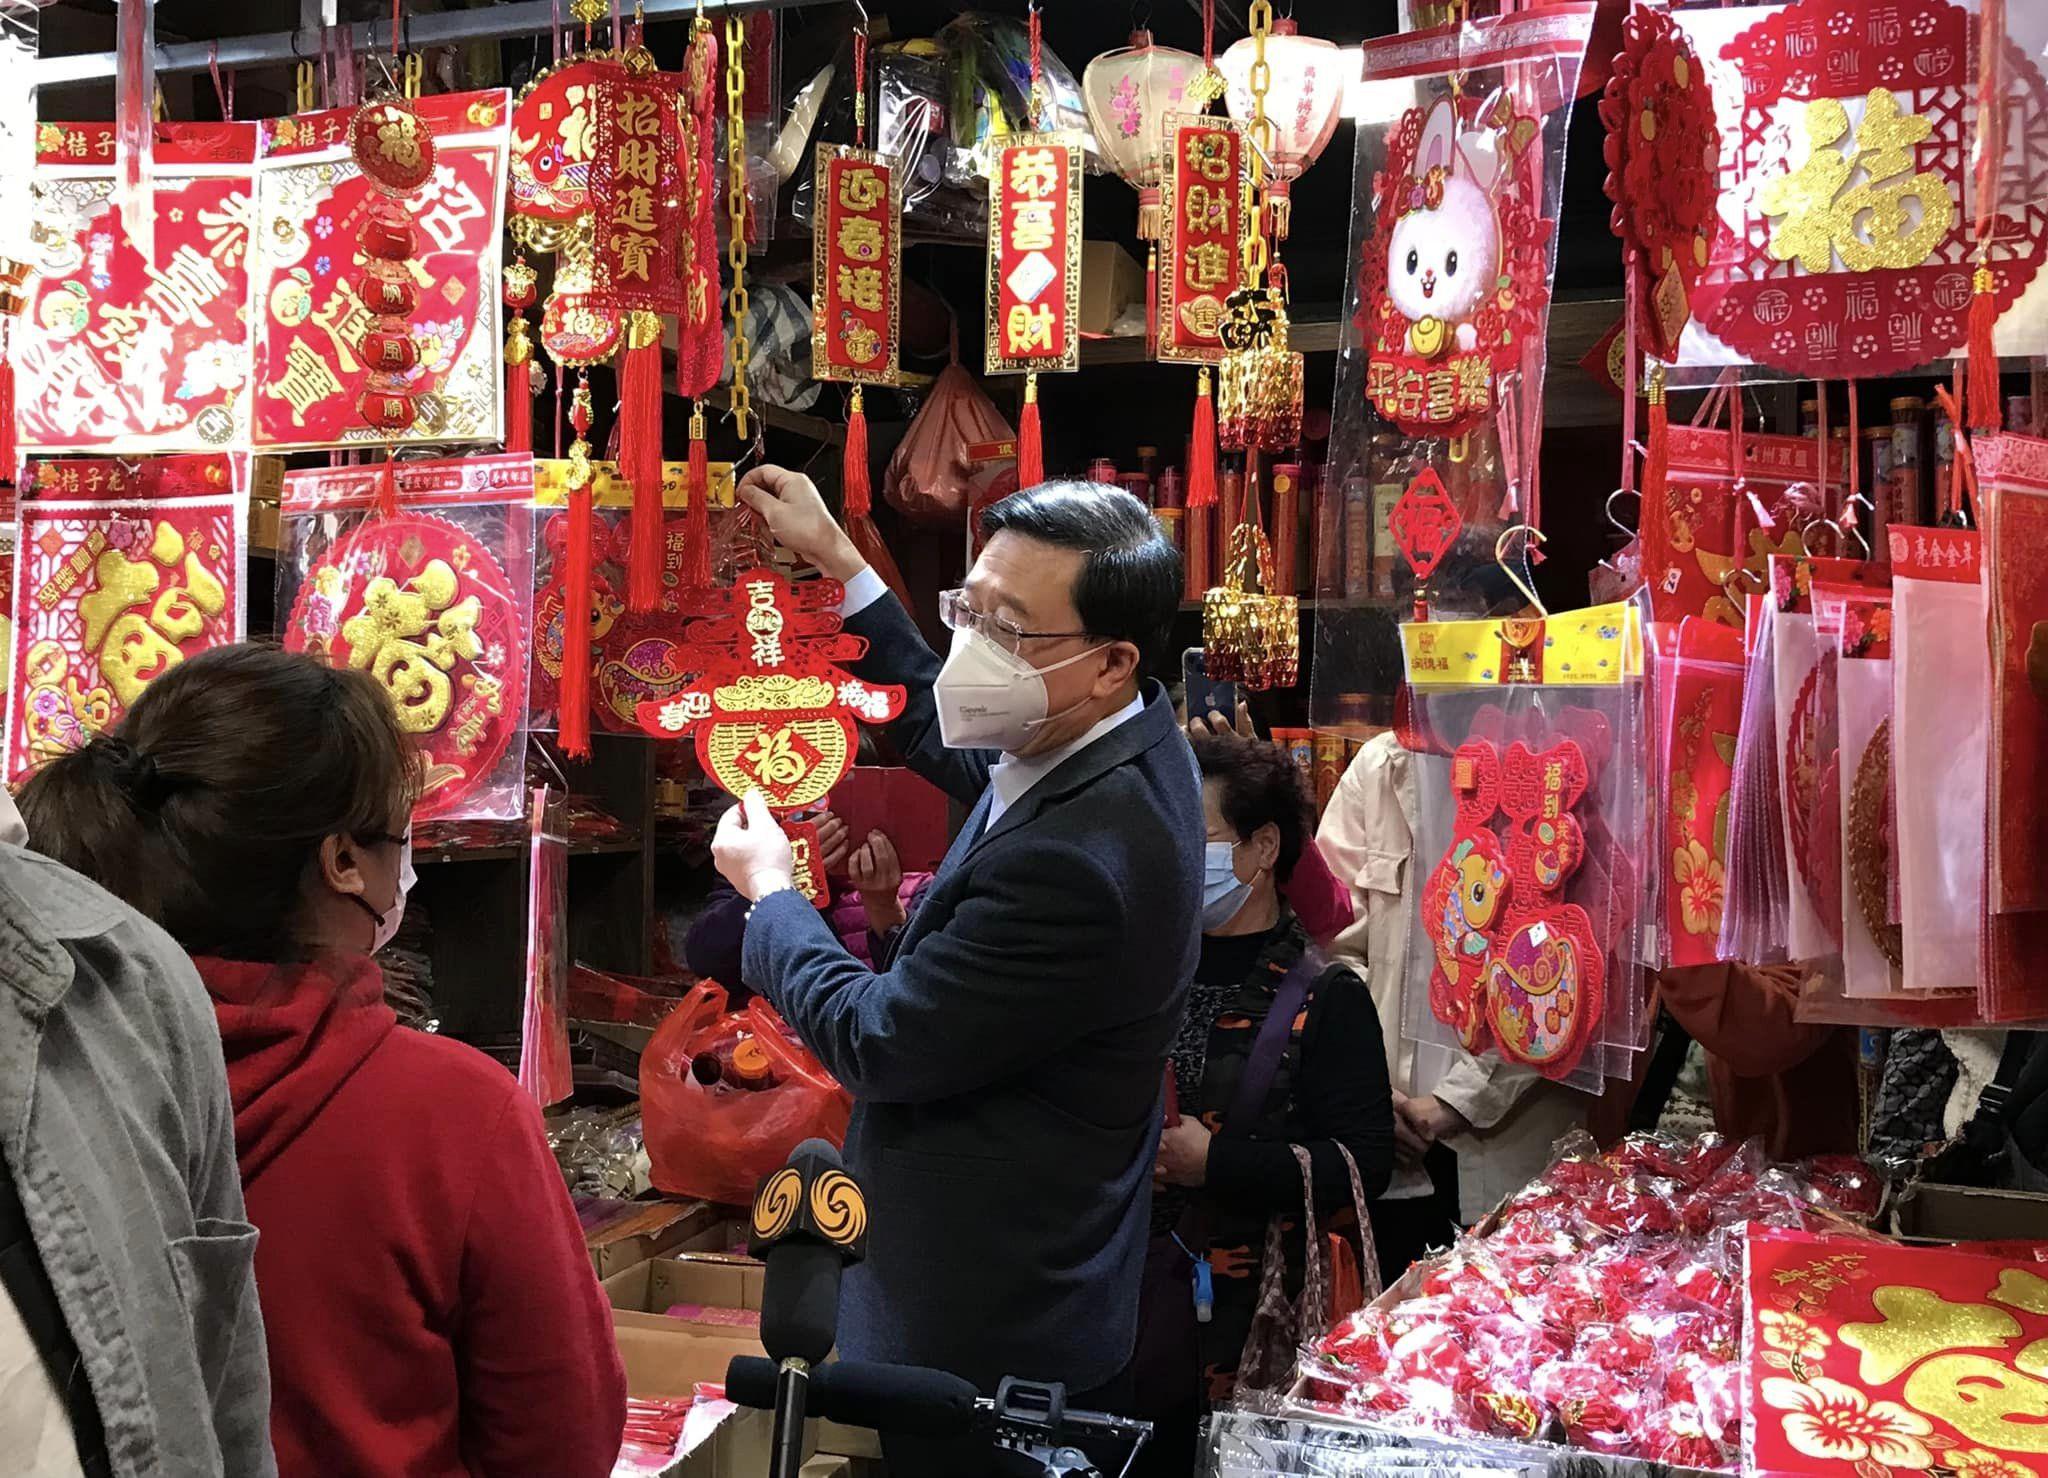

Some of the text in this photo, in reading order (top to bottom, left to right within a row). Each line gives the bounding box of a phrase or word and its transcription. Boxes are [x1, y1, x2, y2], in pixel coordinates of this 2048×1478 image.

[299, 117, 352, 147] 桔子
[611, 90, 660, 282] 招財進寶
[1760, 87, 1954, 273] 福
[264, 164, 487, 428] 招進寶
[1846, 281, 1880, 323] 福
[1367, 355, 1491, 421] 平安喜樂
[343, 558, 484, 733] 福
[746, 579, 785, 668] 吉祥
[745, 726, 806, 785] 福
